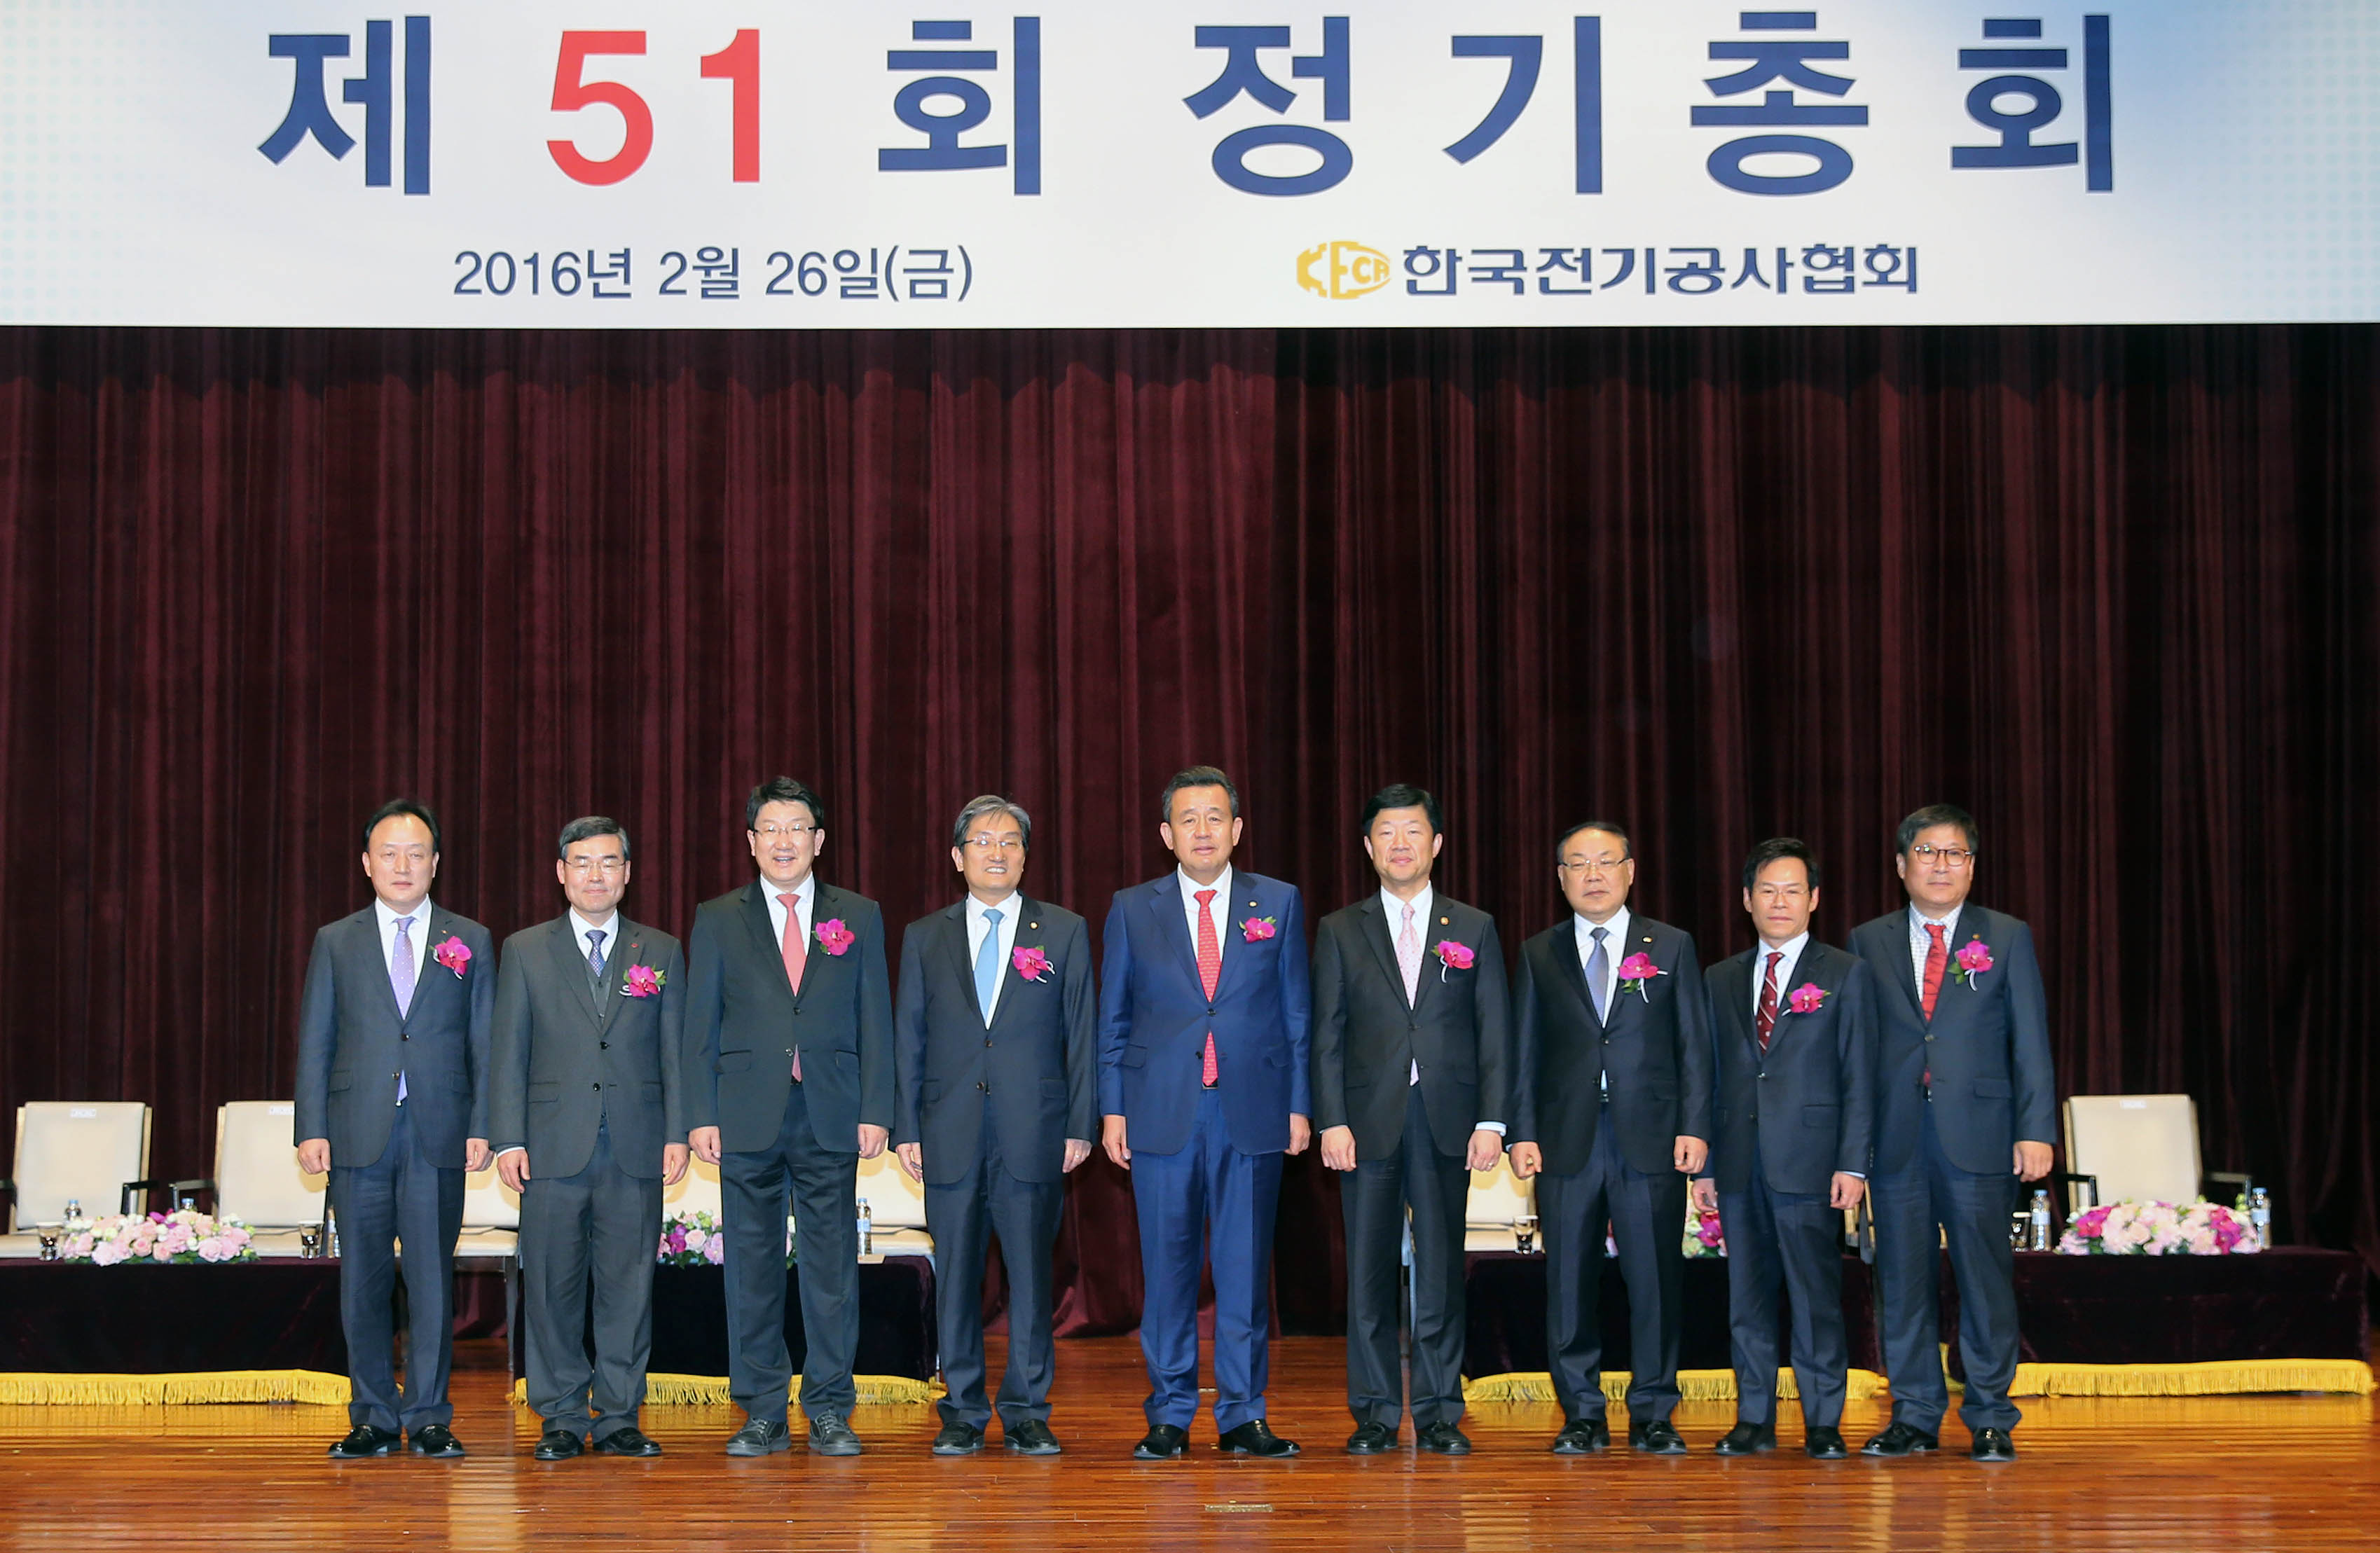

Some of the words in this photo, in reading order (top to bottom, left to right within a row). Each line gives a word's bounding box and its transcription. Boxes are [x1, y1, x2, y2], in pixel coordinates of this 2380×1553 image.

[453, 247, 631, 298] 2016년
[659, 247, 739, 298] 2월
[765, 245, 972, 301] 26일(금)
[1403, 243, 1918, 295] 한국전기공사협회
